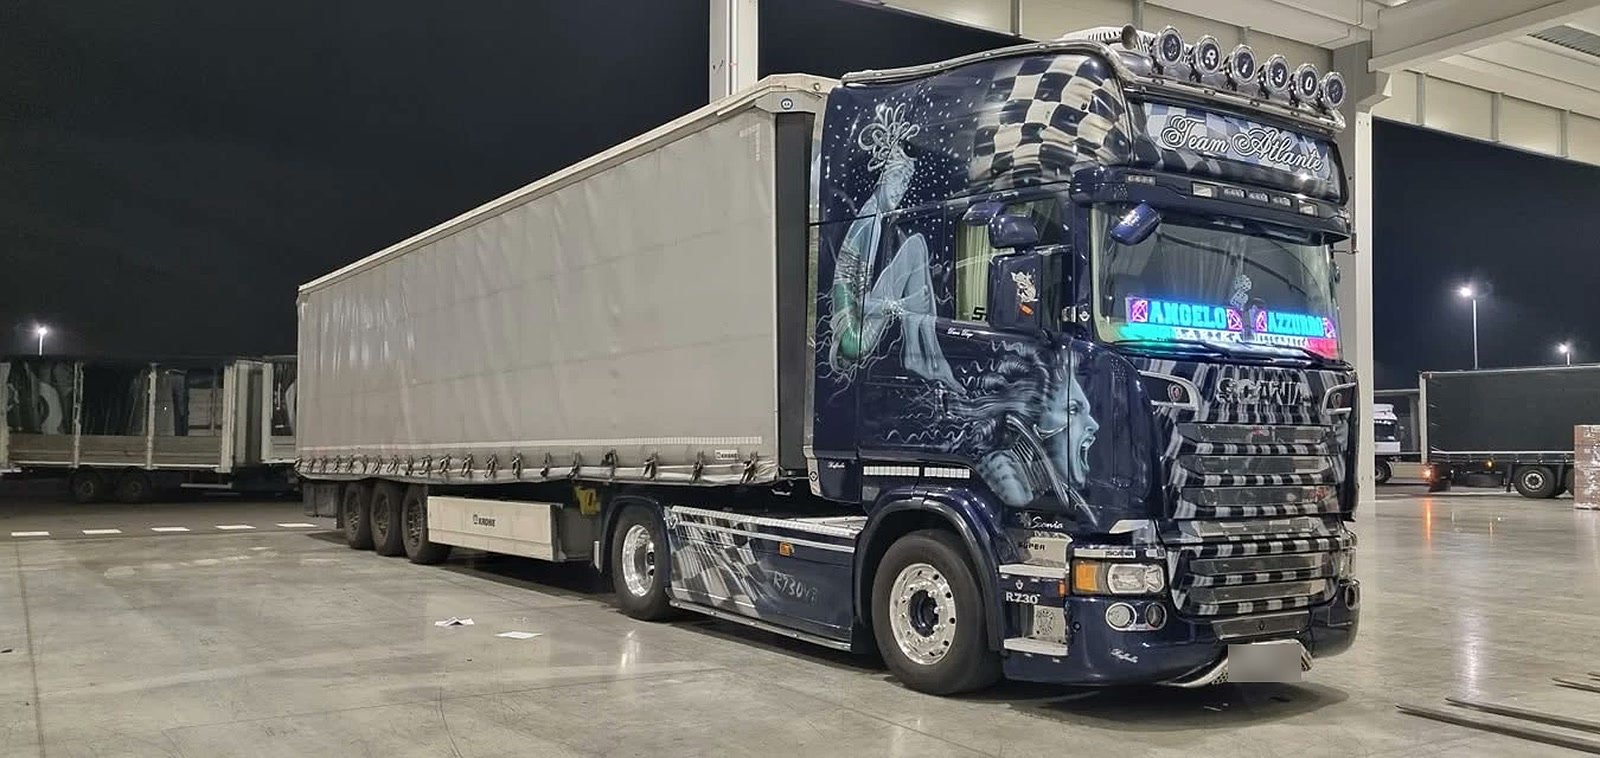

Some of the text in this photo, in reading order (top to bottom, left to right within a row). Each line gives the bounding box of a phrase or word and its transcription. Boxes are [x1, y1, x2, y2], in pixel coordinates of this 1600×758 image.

[1276, 68, 1284, 83] 3
[1161, 115, 1325, 172] Team Atlante
[1149, 300, 1227, 329] ANGELO
[1216, 378, 1311, 407] SCANIA
[1005, 591, 1040, 605] R730
